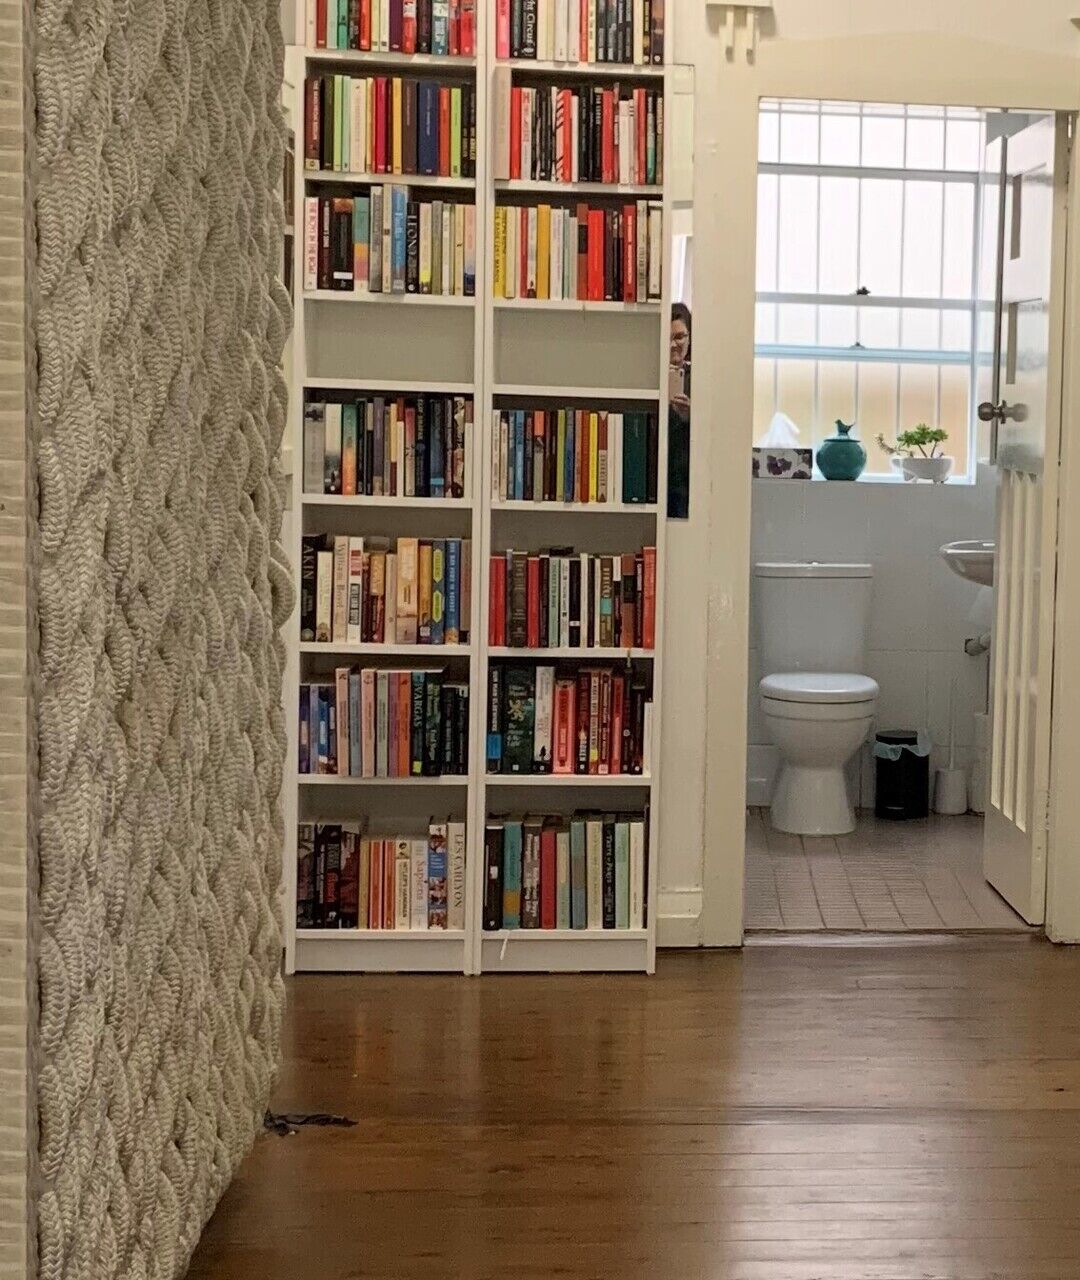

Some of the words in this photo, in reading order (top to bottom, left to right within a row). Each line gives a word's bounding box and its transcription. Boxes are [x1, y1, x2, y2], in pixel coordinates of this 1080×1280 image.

[526, 12, 536, 44] Circus
[303, 545, 315, 580] AKIN
[413, 686, 423, 728] VARGAS
[413, 860, 426, 901] Sapiens
